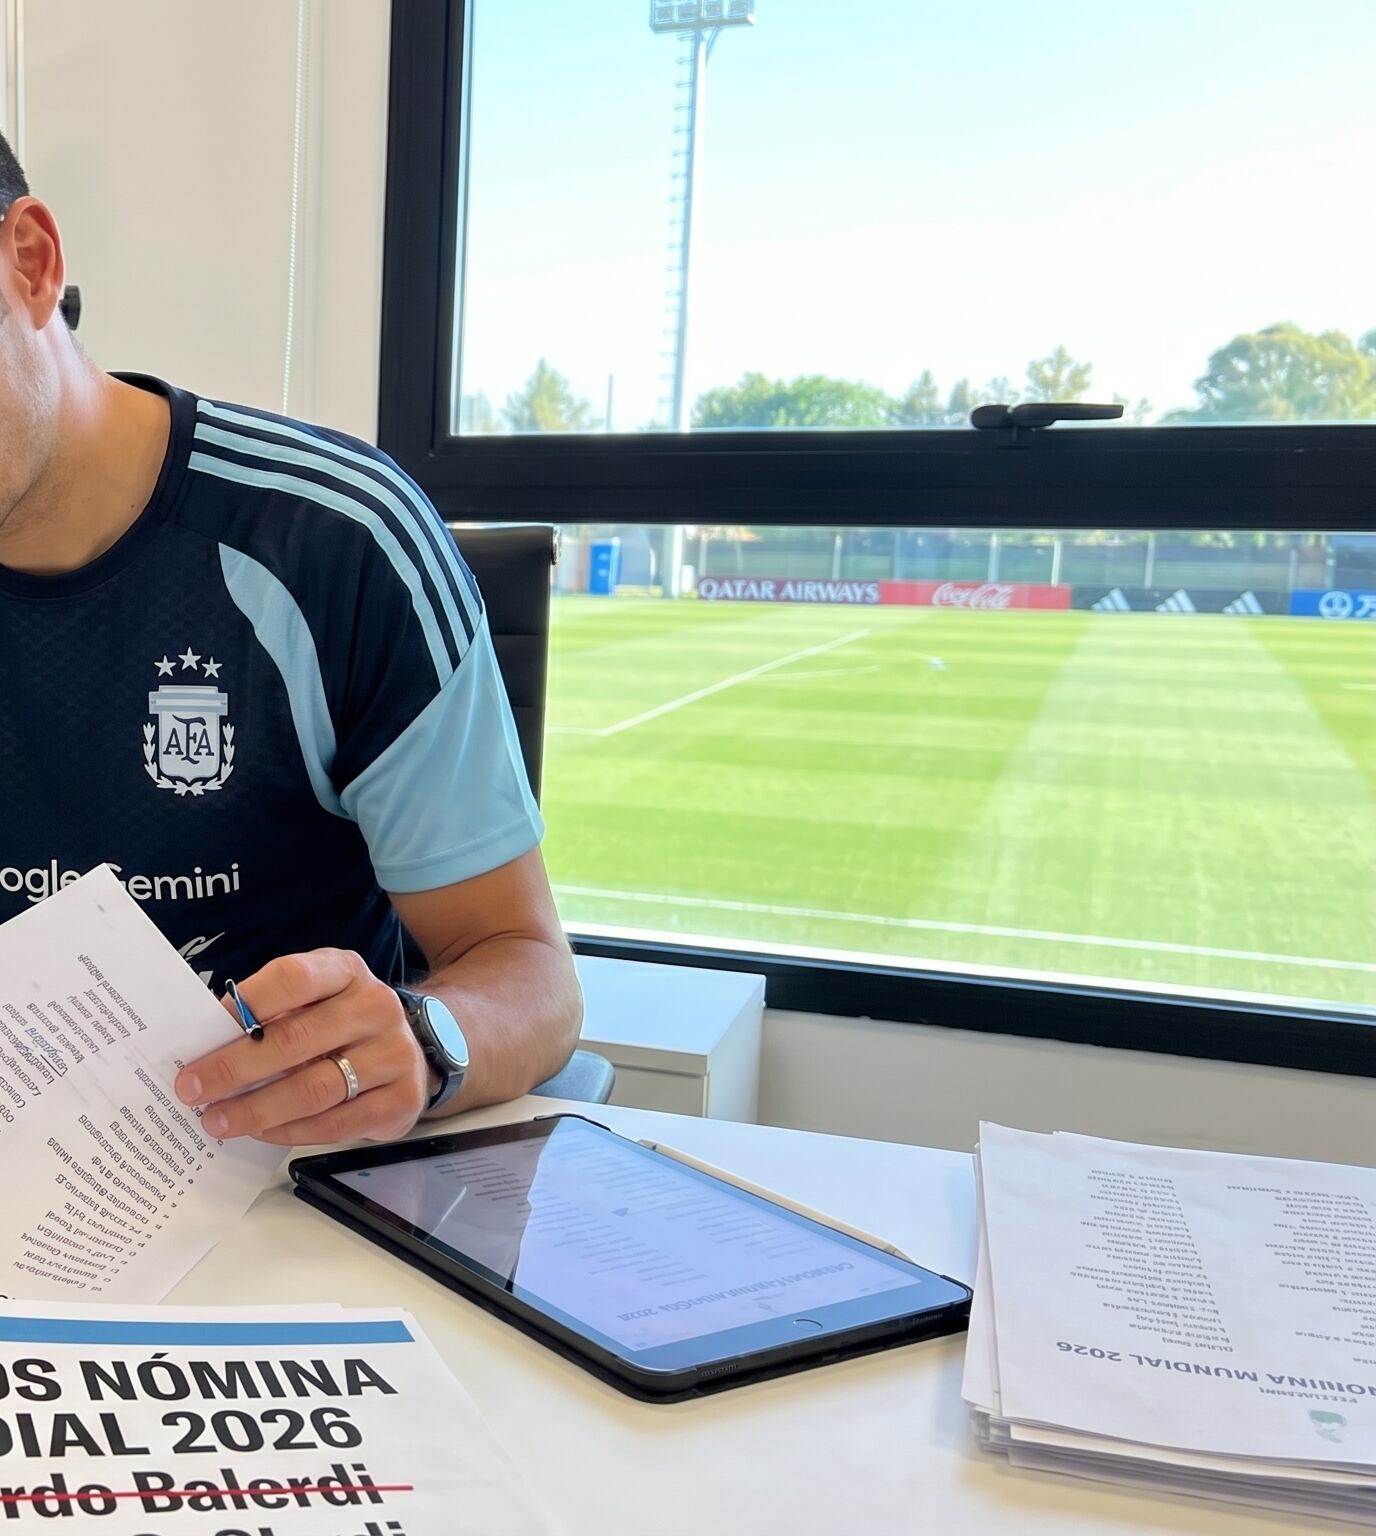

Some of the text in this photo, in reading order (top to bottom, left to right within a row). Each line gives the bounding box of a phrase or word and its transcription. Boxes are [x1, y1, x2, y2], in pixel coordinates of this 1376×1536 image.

[699, 578, 879, 603] QATAR AIRWAYS
[1056, 1341, 1122, 1362] 2026
[1129, 1353, 1258, 1382] MUNDIAL
[78, 1352, 399, 1401] NÓMINA
[161, 1407, 363, 1454] 2026
[132, 1463, 384, 1514] Balerdi
